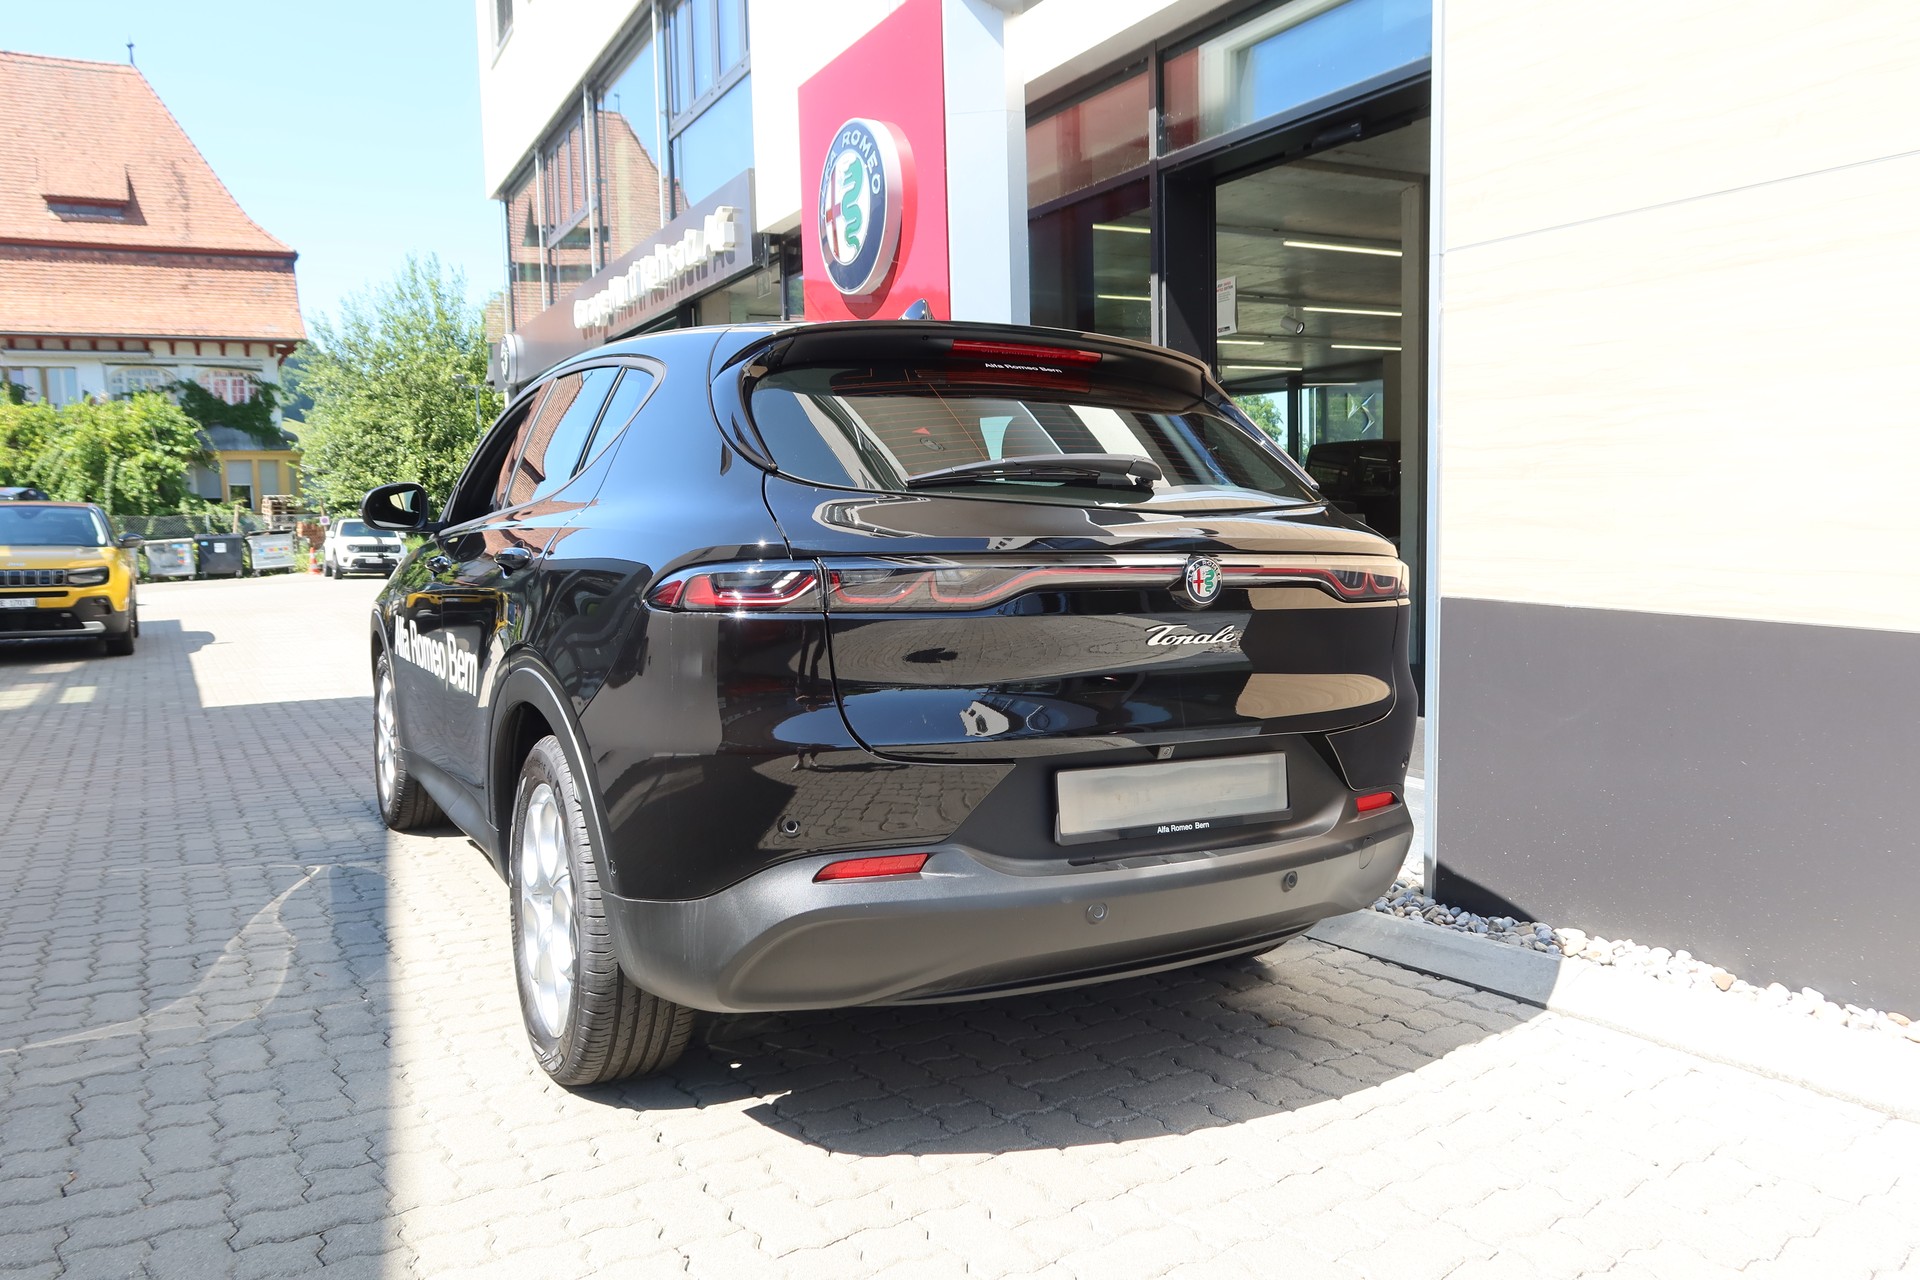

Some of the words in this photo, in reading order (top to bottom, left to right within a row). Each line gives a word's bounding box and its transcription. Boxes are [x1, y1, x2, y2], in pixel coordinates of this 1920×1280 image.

[841, 129, 882, 195] ROMEO
[1004, 363, 1039, 372] Romeo
[1038, 366, 1063, 374] Bern
[1145, 623, 1236, 646] Tonale
[395, 614, 411, 663] Alfa
[409, 619, 447, 680] Romeo
[446, 631, 478, 697] Bern
[1157, 825, 1170, 834] Alfa
